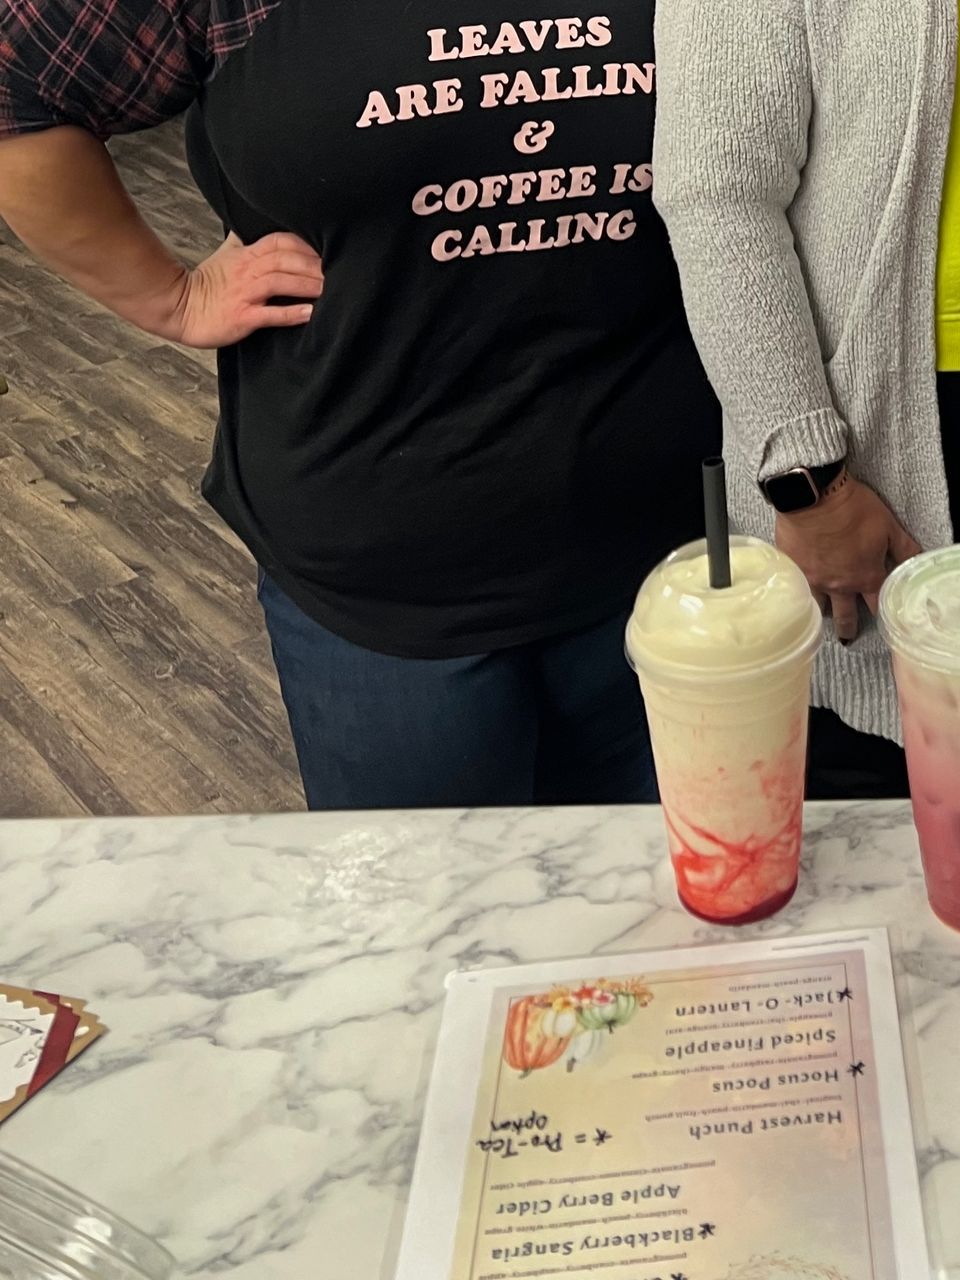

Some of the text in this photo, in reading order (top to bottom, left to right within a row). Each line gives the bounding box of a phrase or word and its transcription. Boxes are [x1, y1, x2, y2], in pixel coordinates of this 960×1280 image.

[427, 16, 612, 61] LEAVES
[356, 62, 656, 128] ARE FALLIN
[513, 120, 555, 154] &
[411, 163, 653, 216] COFFEE IS
[430, 209, 637, 262] CALLING
[675, 1000, 751, 1019] Lantern
[770, 1027, 836, 1049] Spiced
[712, 1069, 838, 1093] Hocus Pocus
[689, 1110, 842, 1141] Harvest Punch
[496, 1183, 681, 1216] Apple Berry Cider
[491, 1227, 695, 1262] Blackberry Sangria
